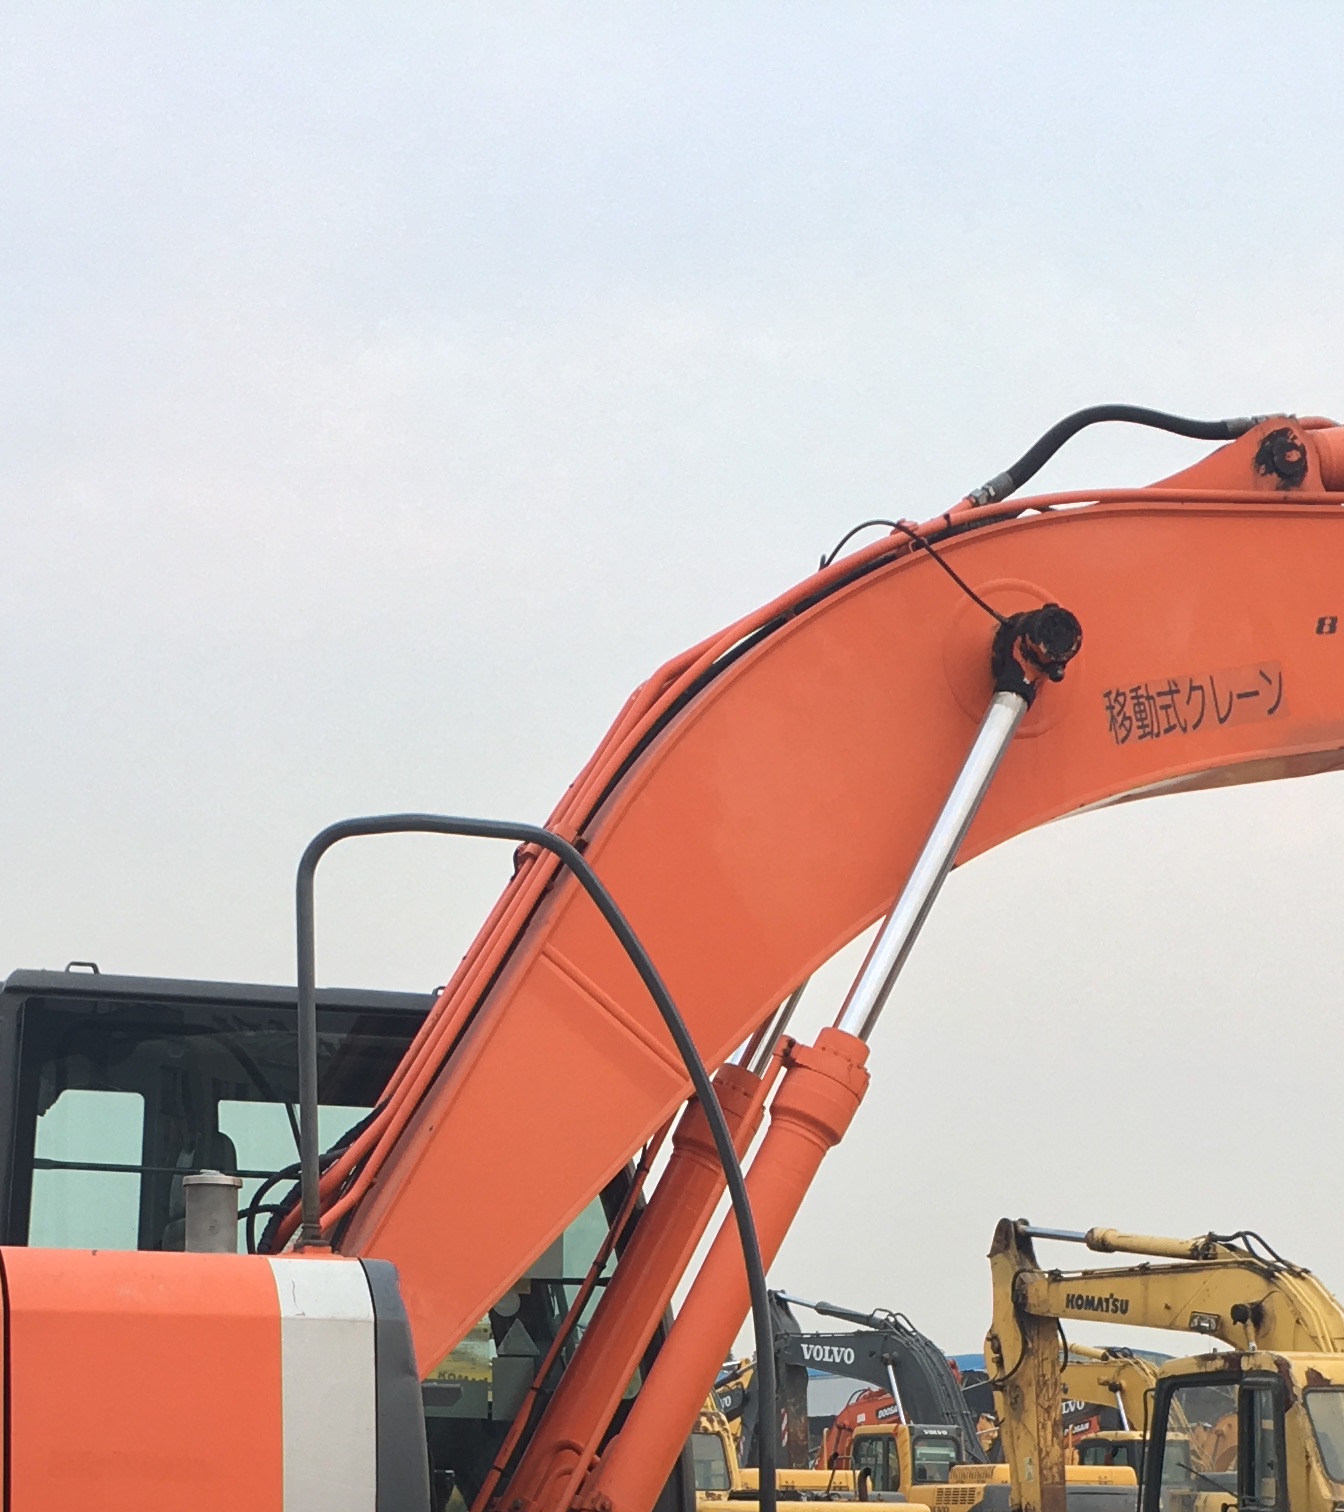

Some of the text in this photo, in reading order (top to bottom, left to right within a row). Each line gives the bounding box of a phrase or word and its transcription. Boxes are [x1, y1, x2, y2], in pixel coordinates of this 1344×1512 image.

[1103, 668, 1284, 746] 移動式クレーン
[1066, 1293, 1130, 1315] KOMATSU
[801, 1343, 855, 1364] VOLVO
